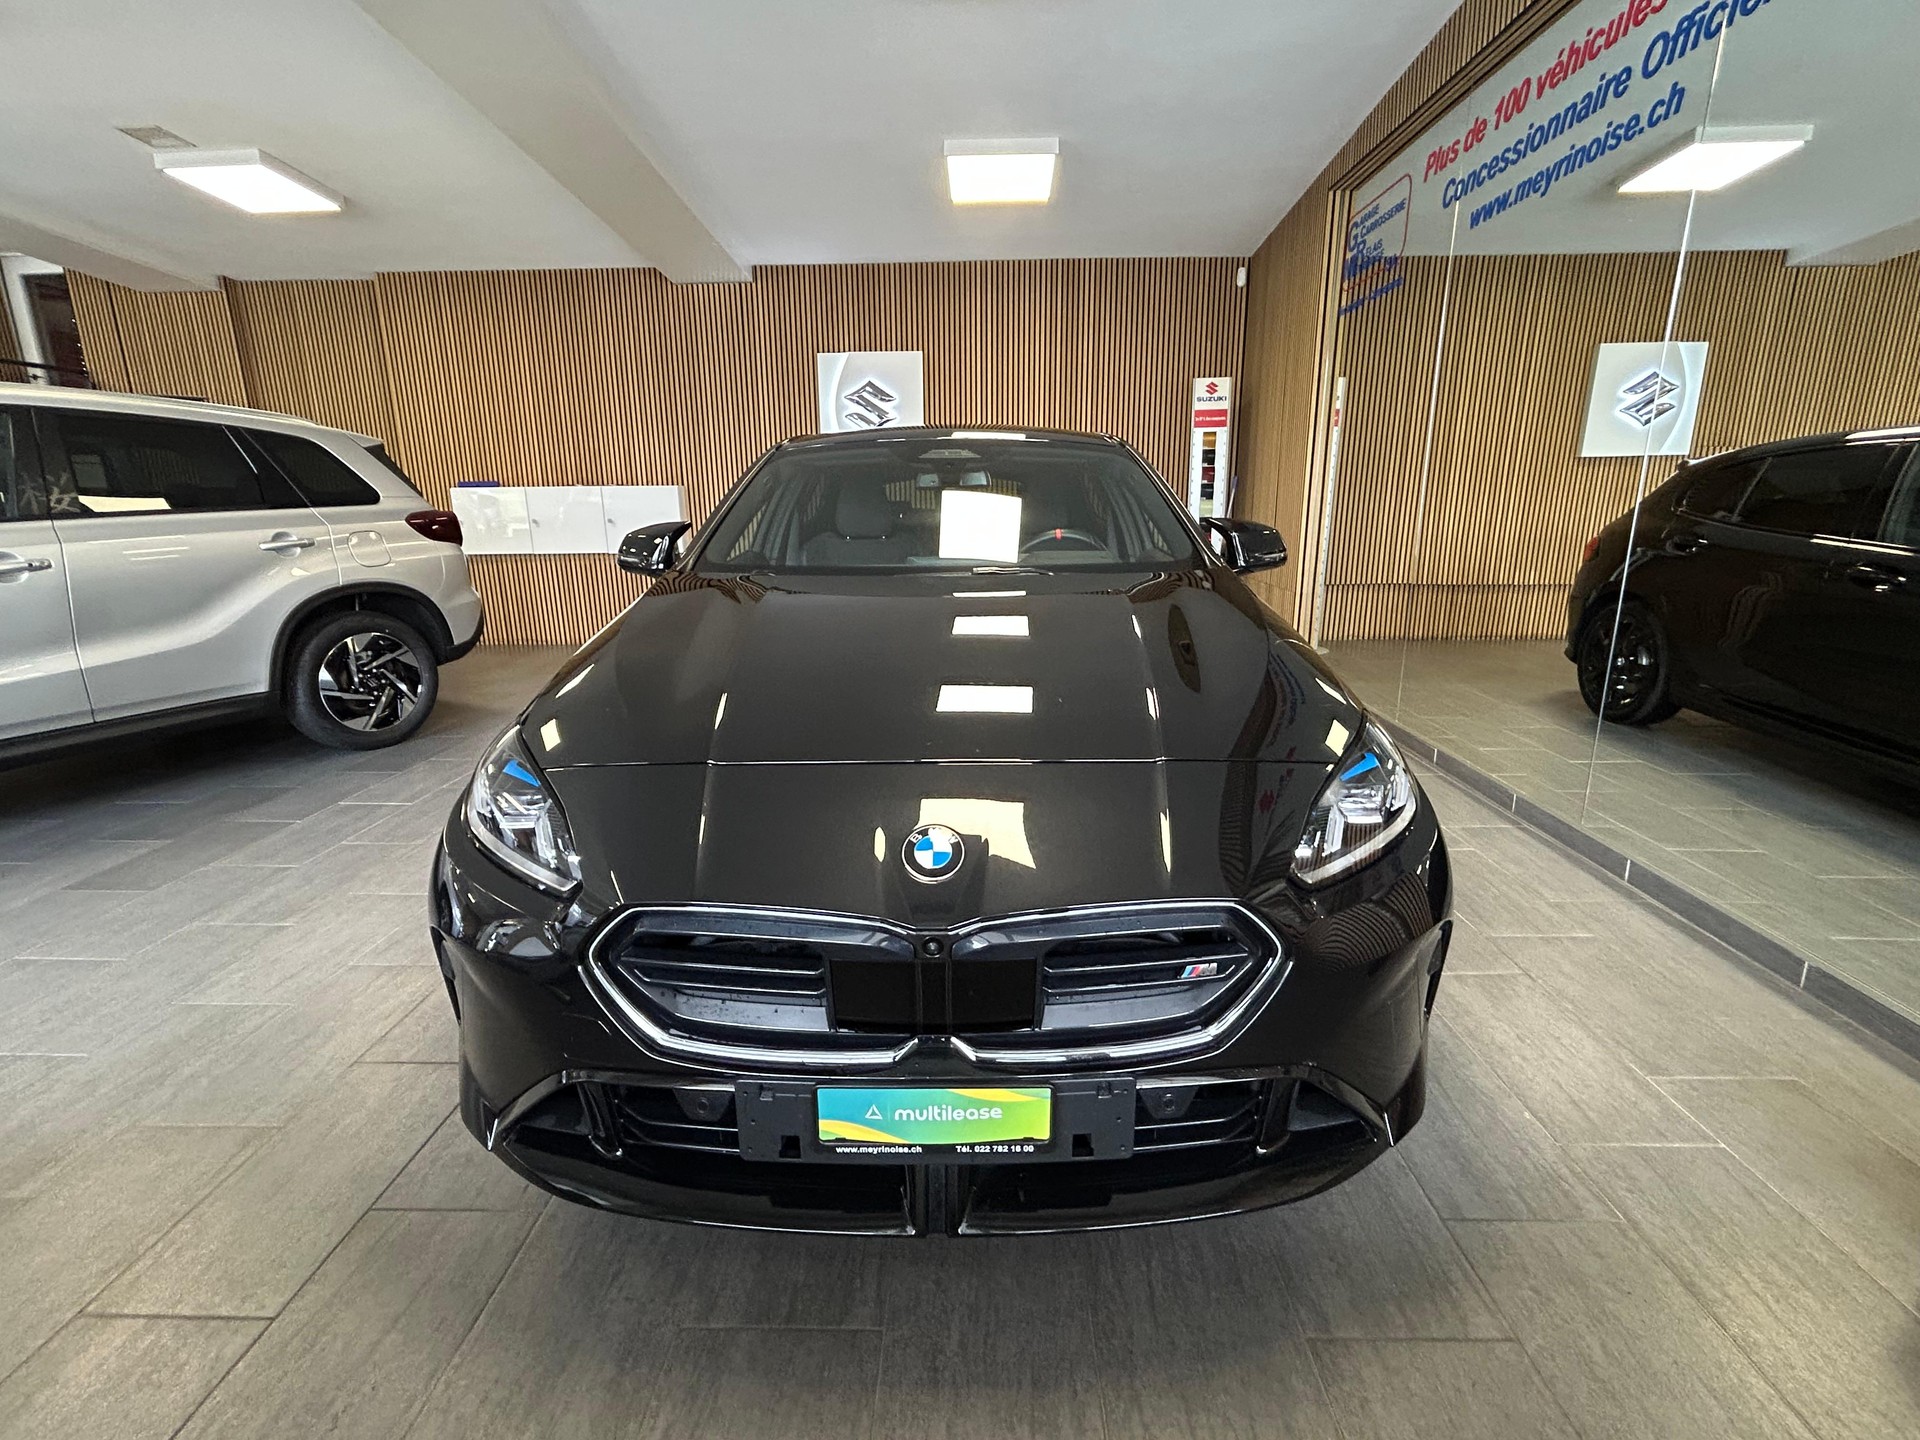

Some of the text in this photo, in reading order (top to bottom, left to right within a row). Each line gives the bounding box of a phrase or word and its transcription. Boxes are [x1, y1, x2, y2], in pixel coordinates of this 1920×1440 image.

[1423, 138, 1461, 183] Plus
[1463, 115, 1488, 152] de
[1494, 76, 1531, 131] 100
[1442, 0, 1771, 210] Concessionnaire Offici
[1469, 80, 1686, 230] www.meyrinoise.ch
[894, 1104, 1003, 1121] multilease
[835, 1145, 923, 1155] www.meyrinoise.ch
[955, 1145, 973, 1153] Tél.
[974, 1145, 991, 1153] 022
[992, 1145, 1009, 1153] 782
[1023, 1145, 1035, 1153] 00
